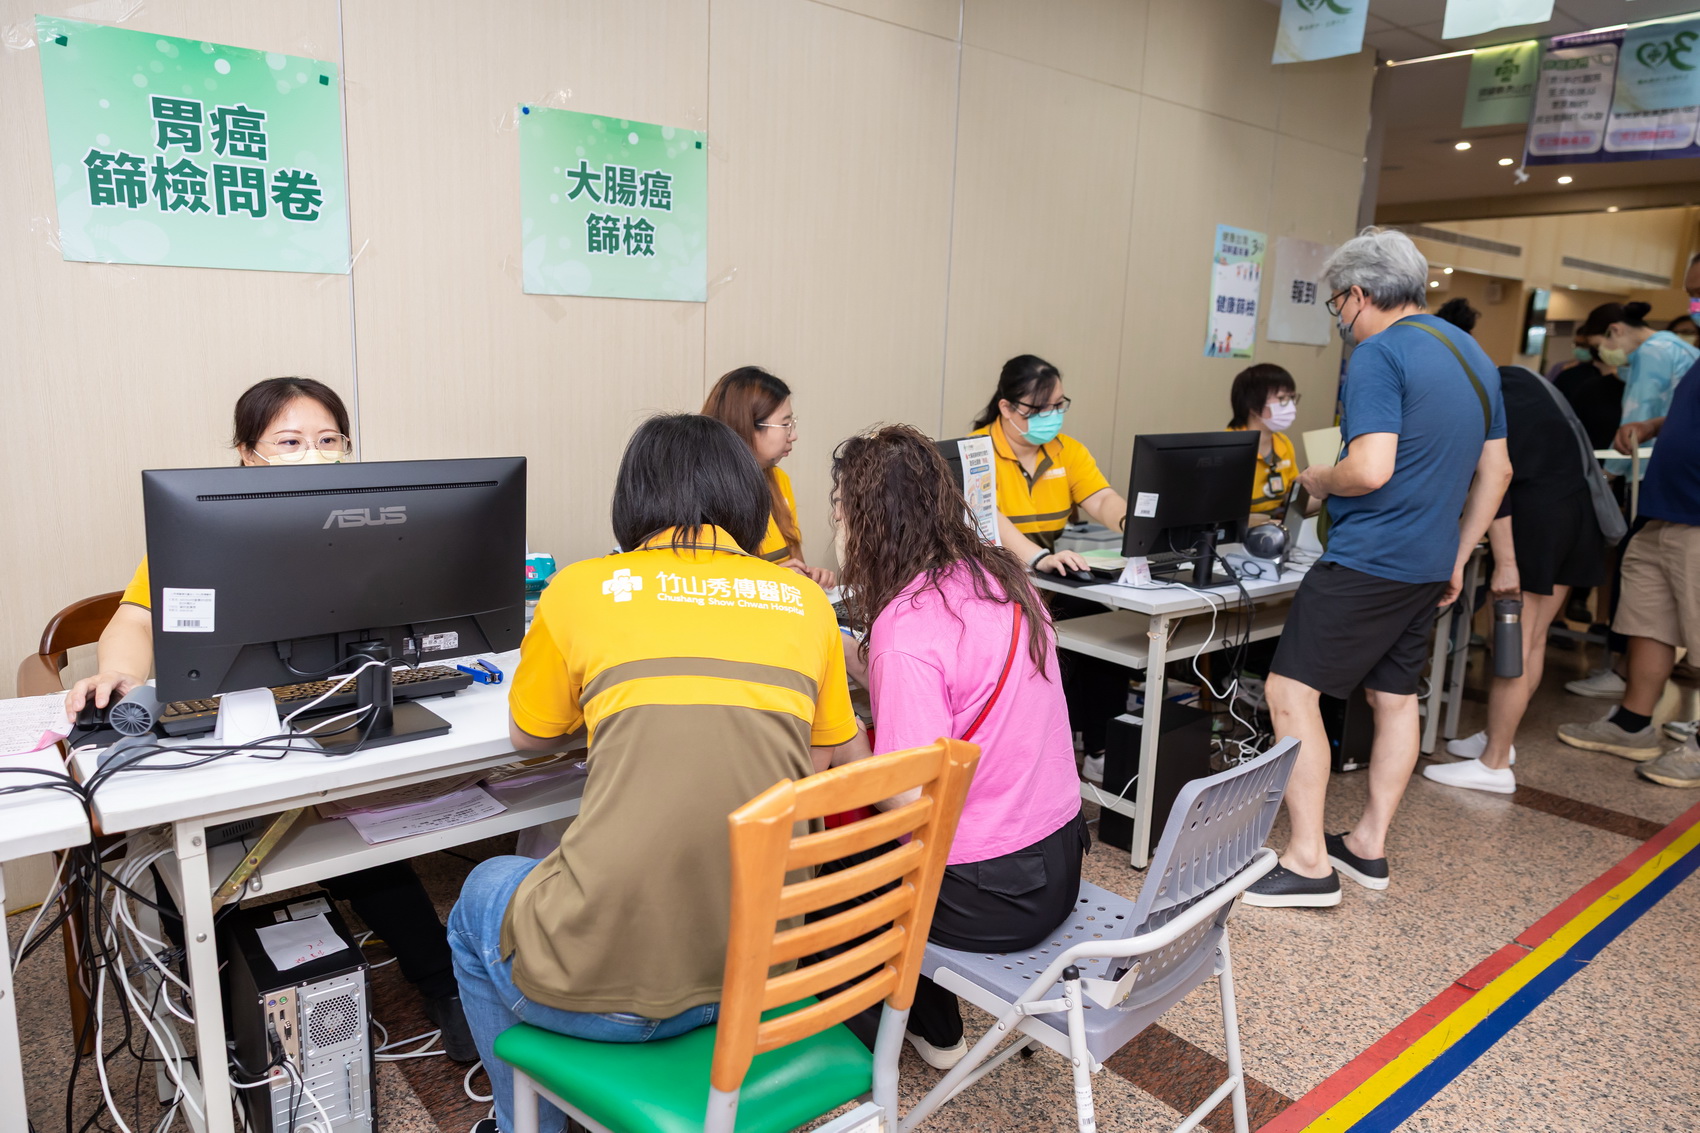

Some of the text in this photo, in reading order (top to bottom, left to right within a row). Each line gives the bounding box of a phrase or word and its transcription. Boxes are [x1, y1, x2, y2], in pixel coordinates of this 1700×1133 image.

[151, 96, 269, 162] 胃癌
[83, 149, 324, 222] 篩檢問卷
[567, 160, 673, 211] 大腸癌
[586, 212, 656, 257] 篩檢
[322, 505, 408, 530] ASUS
[656, 571, 804, 607] 竹山秀傳醫院
[656, 593, 805, 616] Chushang Show Chwan Hospital
